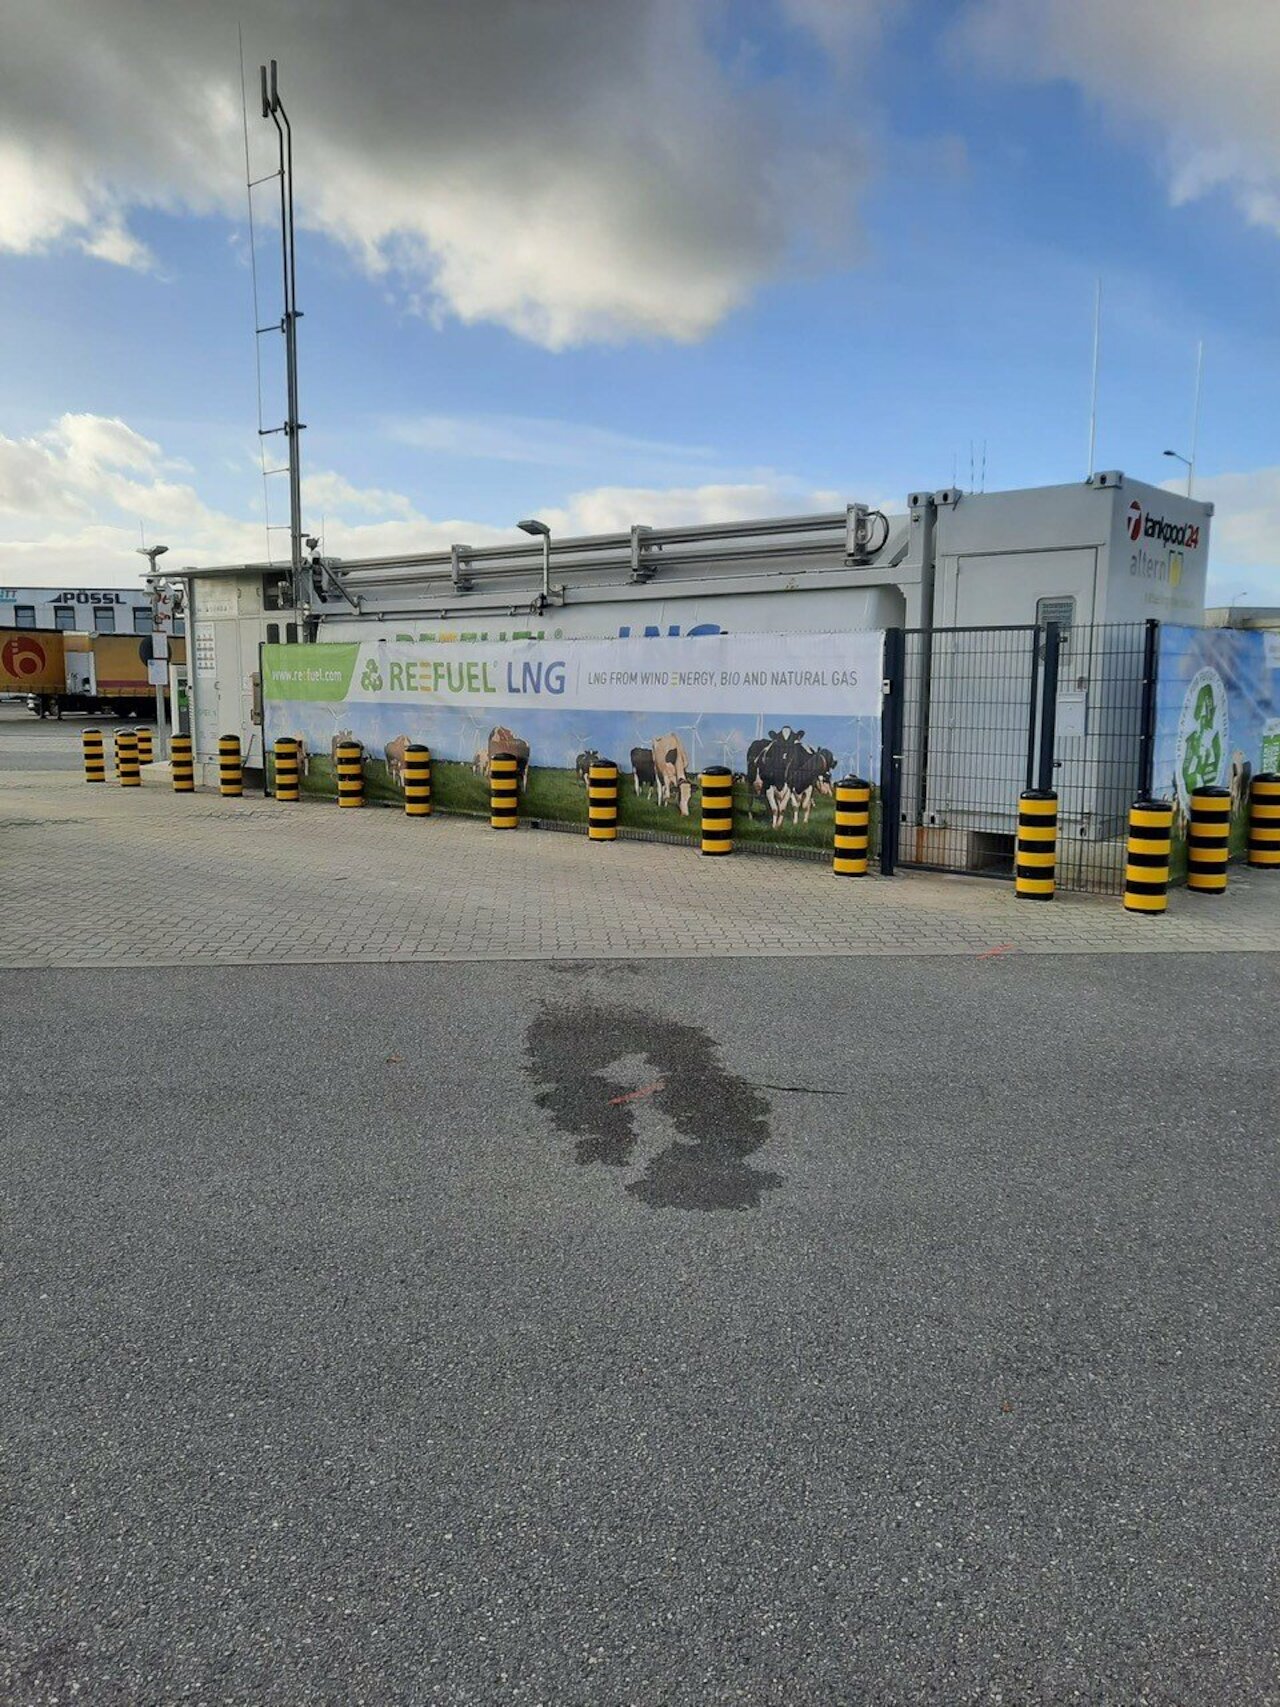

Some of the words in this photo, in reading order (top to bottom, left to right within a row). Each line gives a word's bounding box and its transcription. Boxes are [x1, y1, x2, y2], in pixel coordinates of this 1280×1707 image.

[1144, 512, 1200, 549] tankpool24
[507, 661, 566, 695] LNG
[588, 671, 607, 685] LNG
[610, 671, 638, 685] FROM
[640, 671, 668, 685] WIND
[721, 671, 740, 685] BIO
[743, 671, 767, 685] AND
[771, 671, 827, 686] NATURAL
[832, 671, 858, 686] GAS
